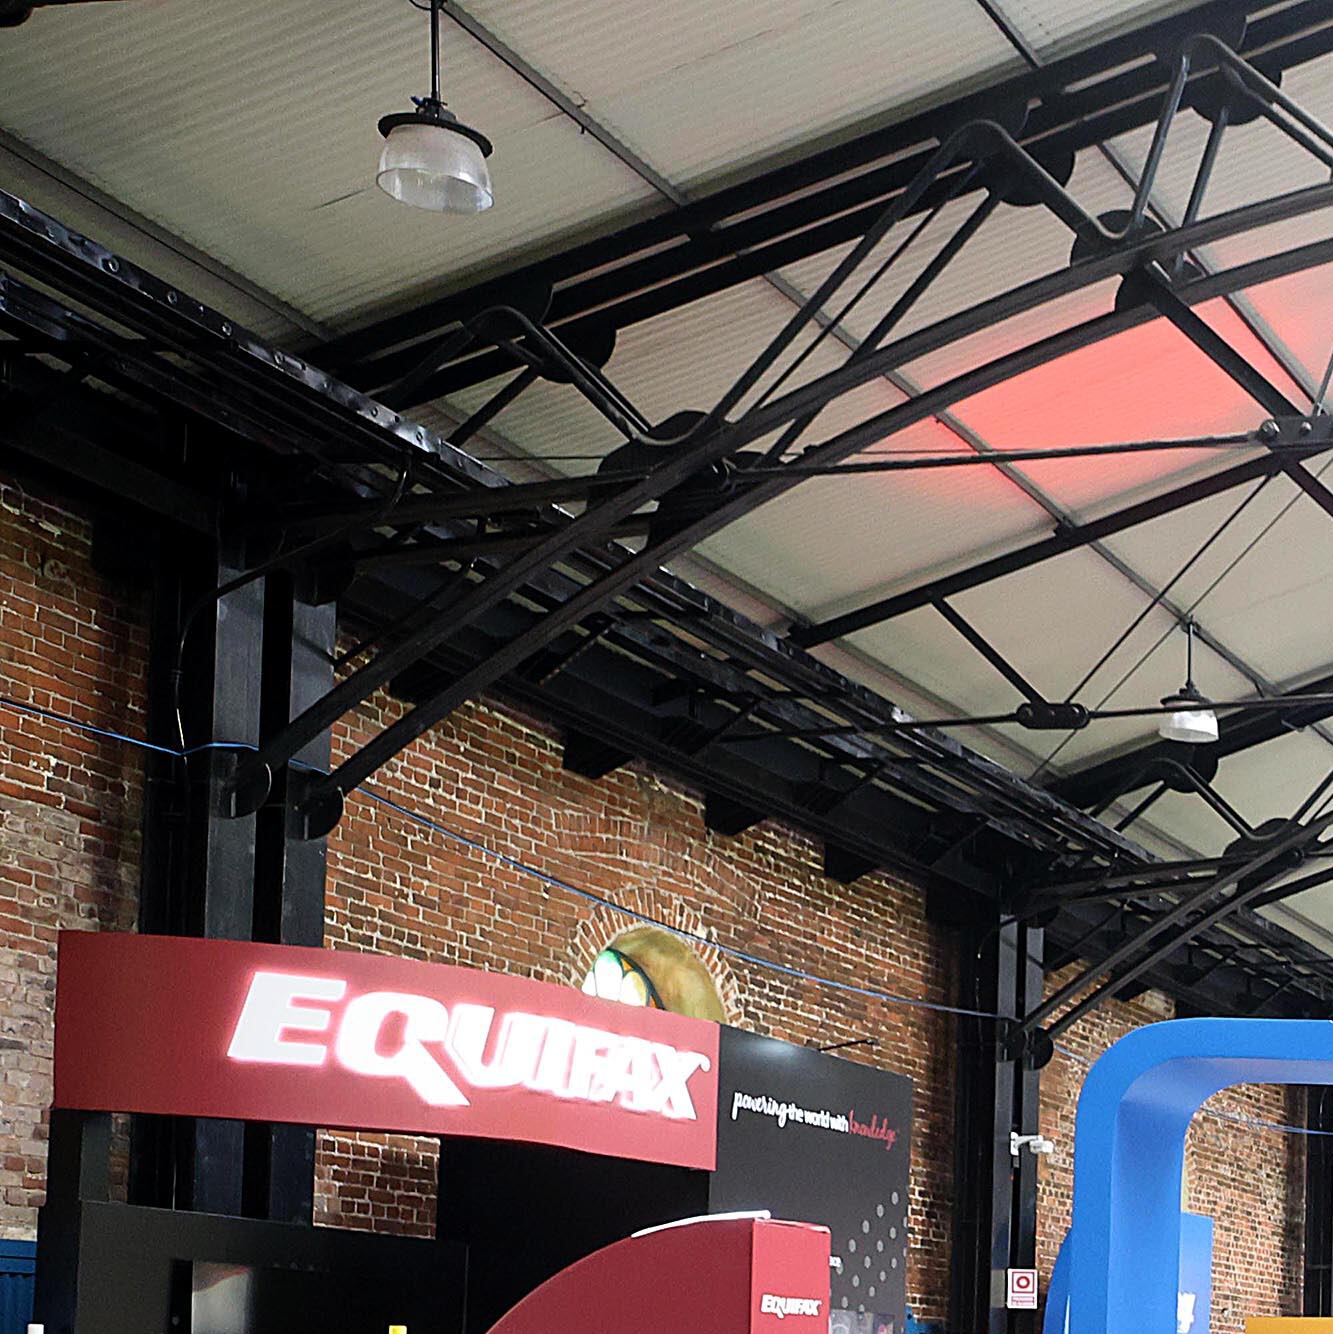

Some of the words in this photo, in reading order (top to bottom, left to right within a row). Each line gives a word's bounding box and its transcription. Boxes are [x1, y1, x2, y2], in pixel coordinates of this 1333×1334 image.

[228, 971, 705, 1121] EQUIFAX
[788, 1102, 804, 1123] the
[805, 1109, 830, 1129] world
[830, 1112, 849, 1133] with
[761, 1294, 822, 1319] EQUIFAX
